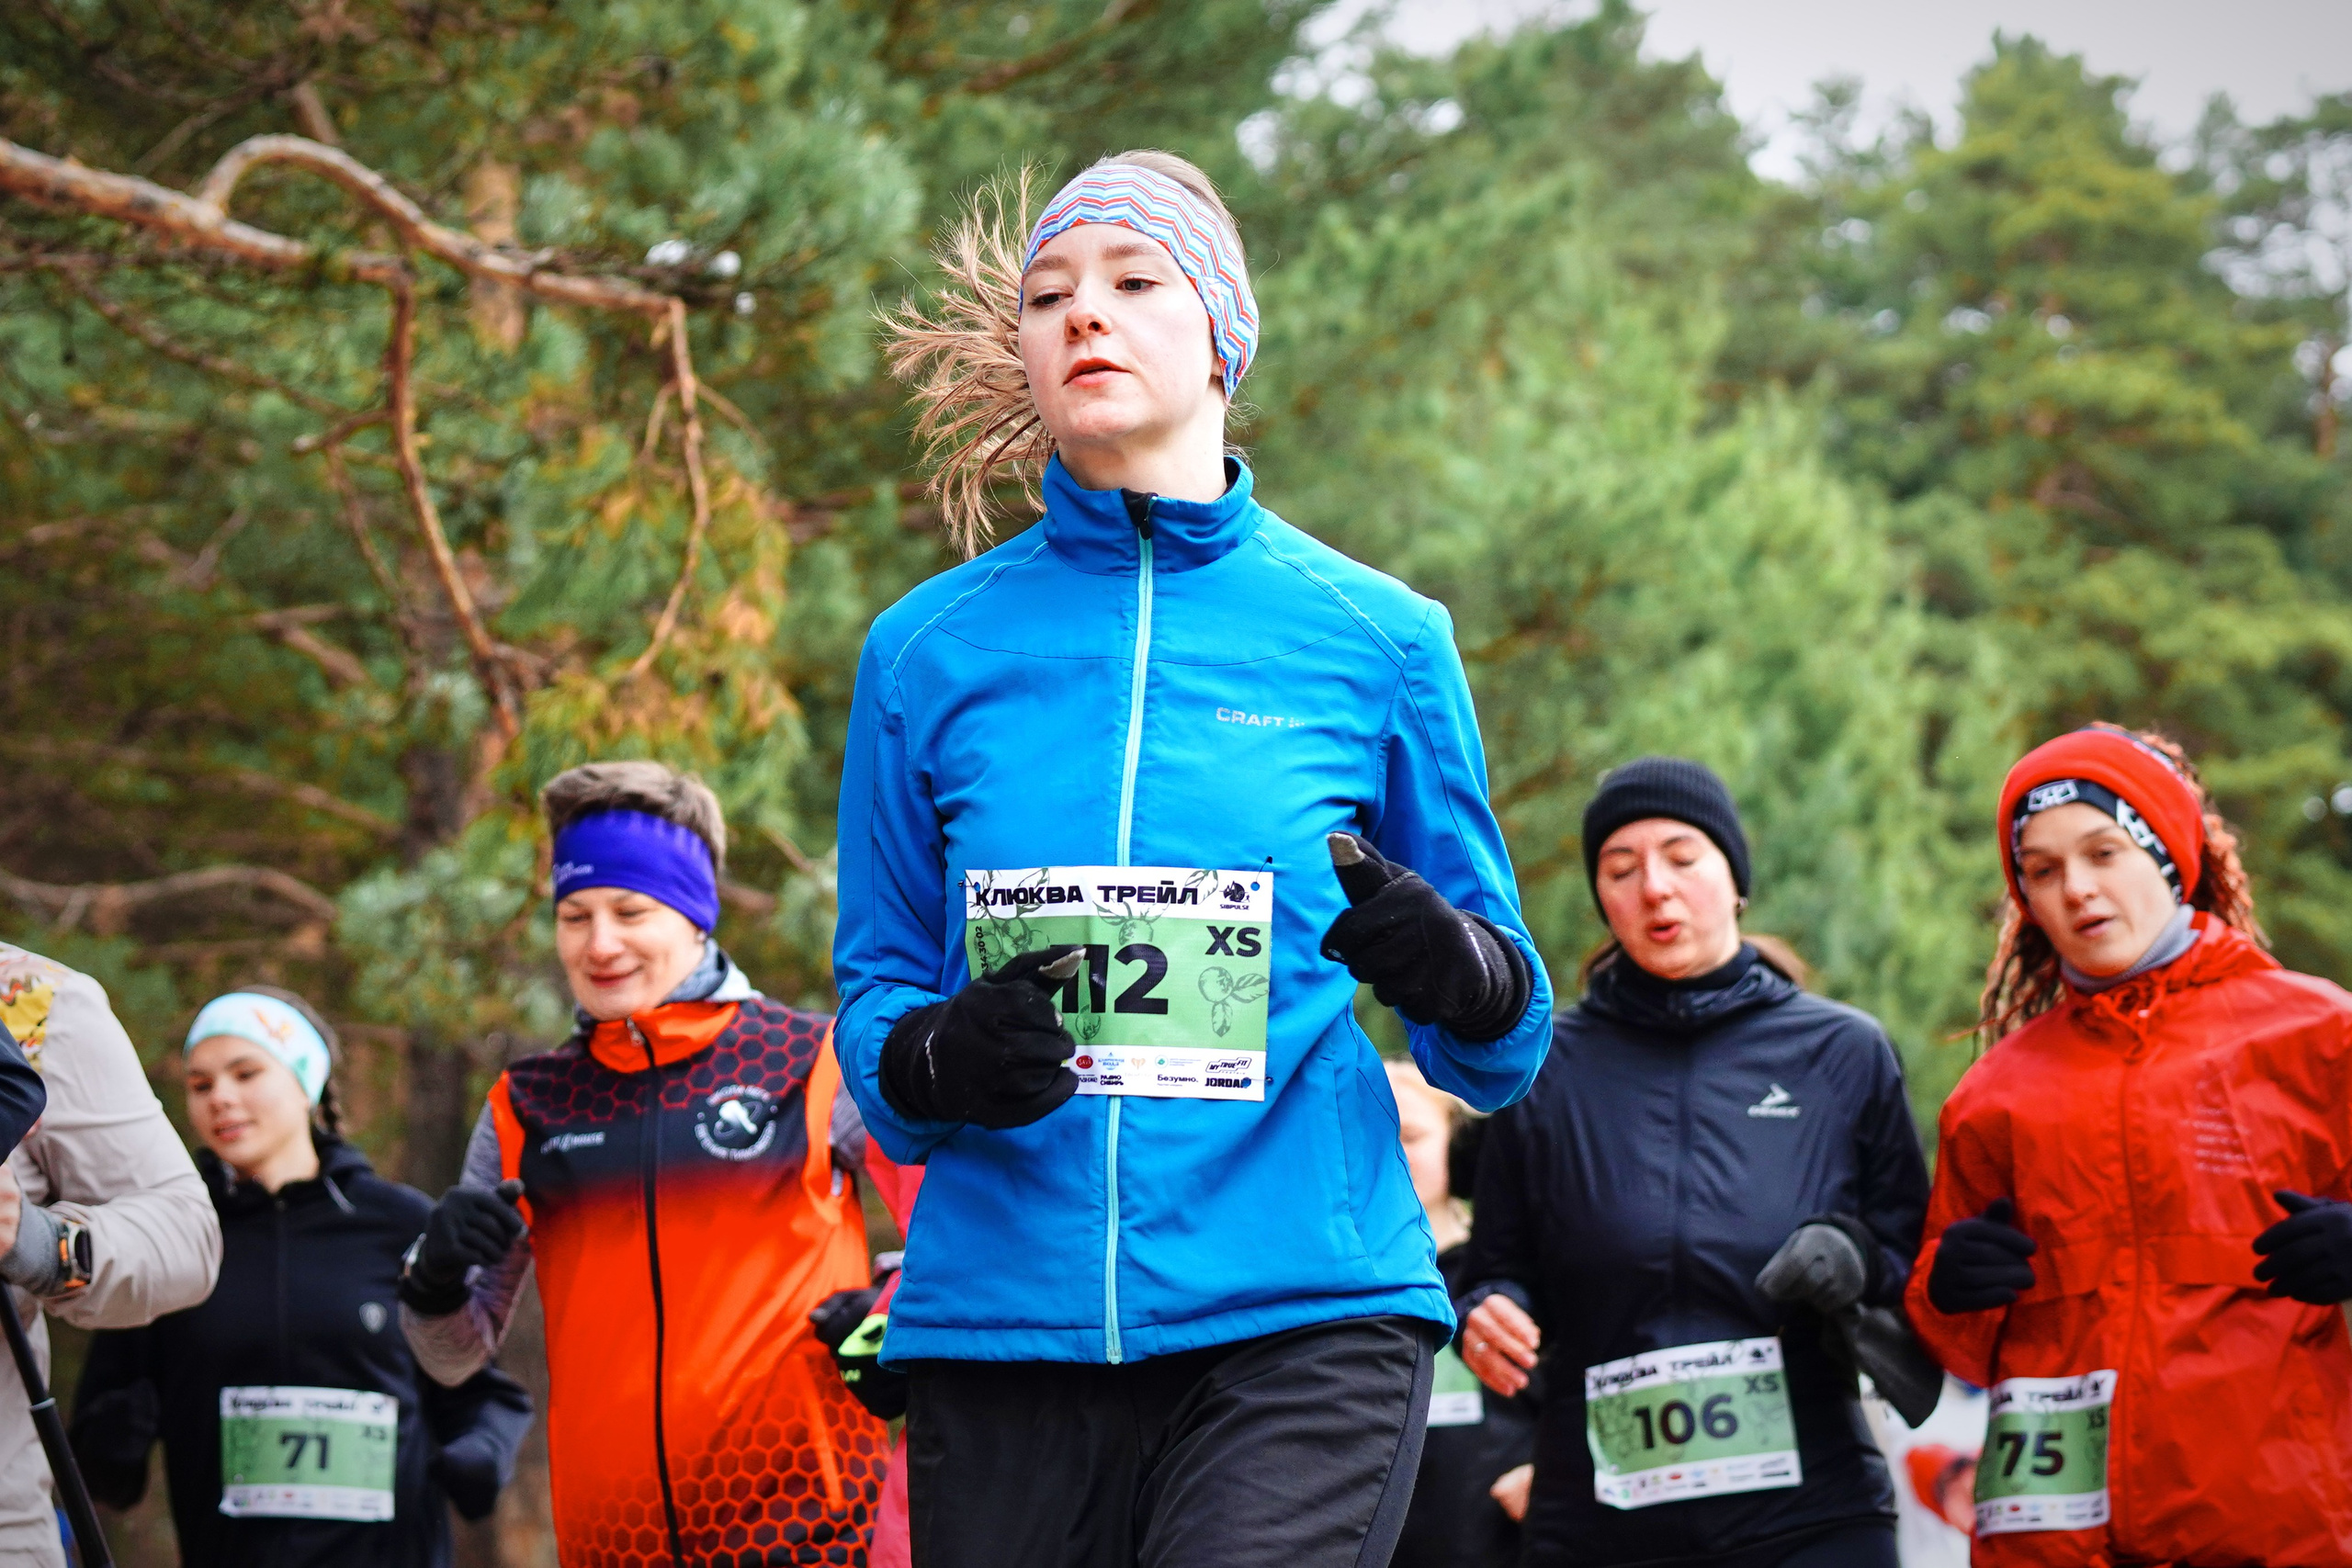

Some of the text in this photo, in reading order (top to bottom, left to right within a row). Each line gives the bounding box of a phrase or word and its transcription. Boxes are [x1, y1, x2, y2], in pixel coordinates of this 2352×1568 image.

[1216, 706, 1284, 727] CRAFT
[976, 880, 1198, 906] КЛЮКВА ТРЕЙЛ
[1205, 925, 1262, 957] XS
[1744, 1374, 1781, 1393] XS
[1633, 1393, 1739, 1450] 106
[279, 1430, 329, 1471] 71
[1996, 1431, 2064, 1477] 75
